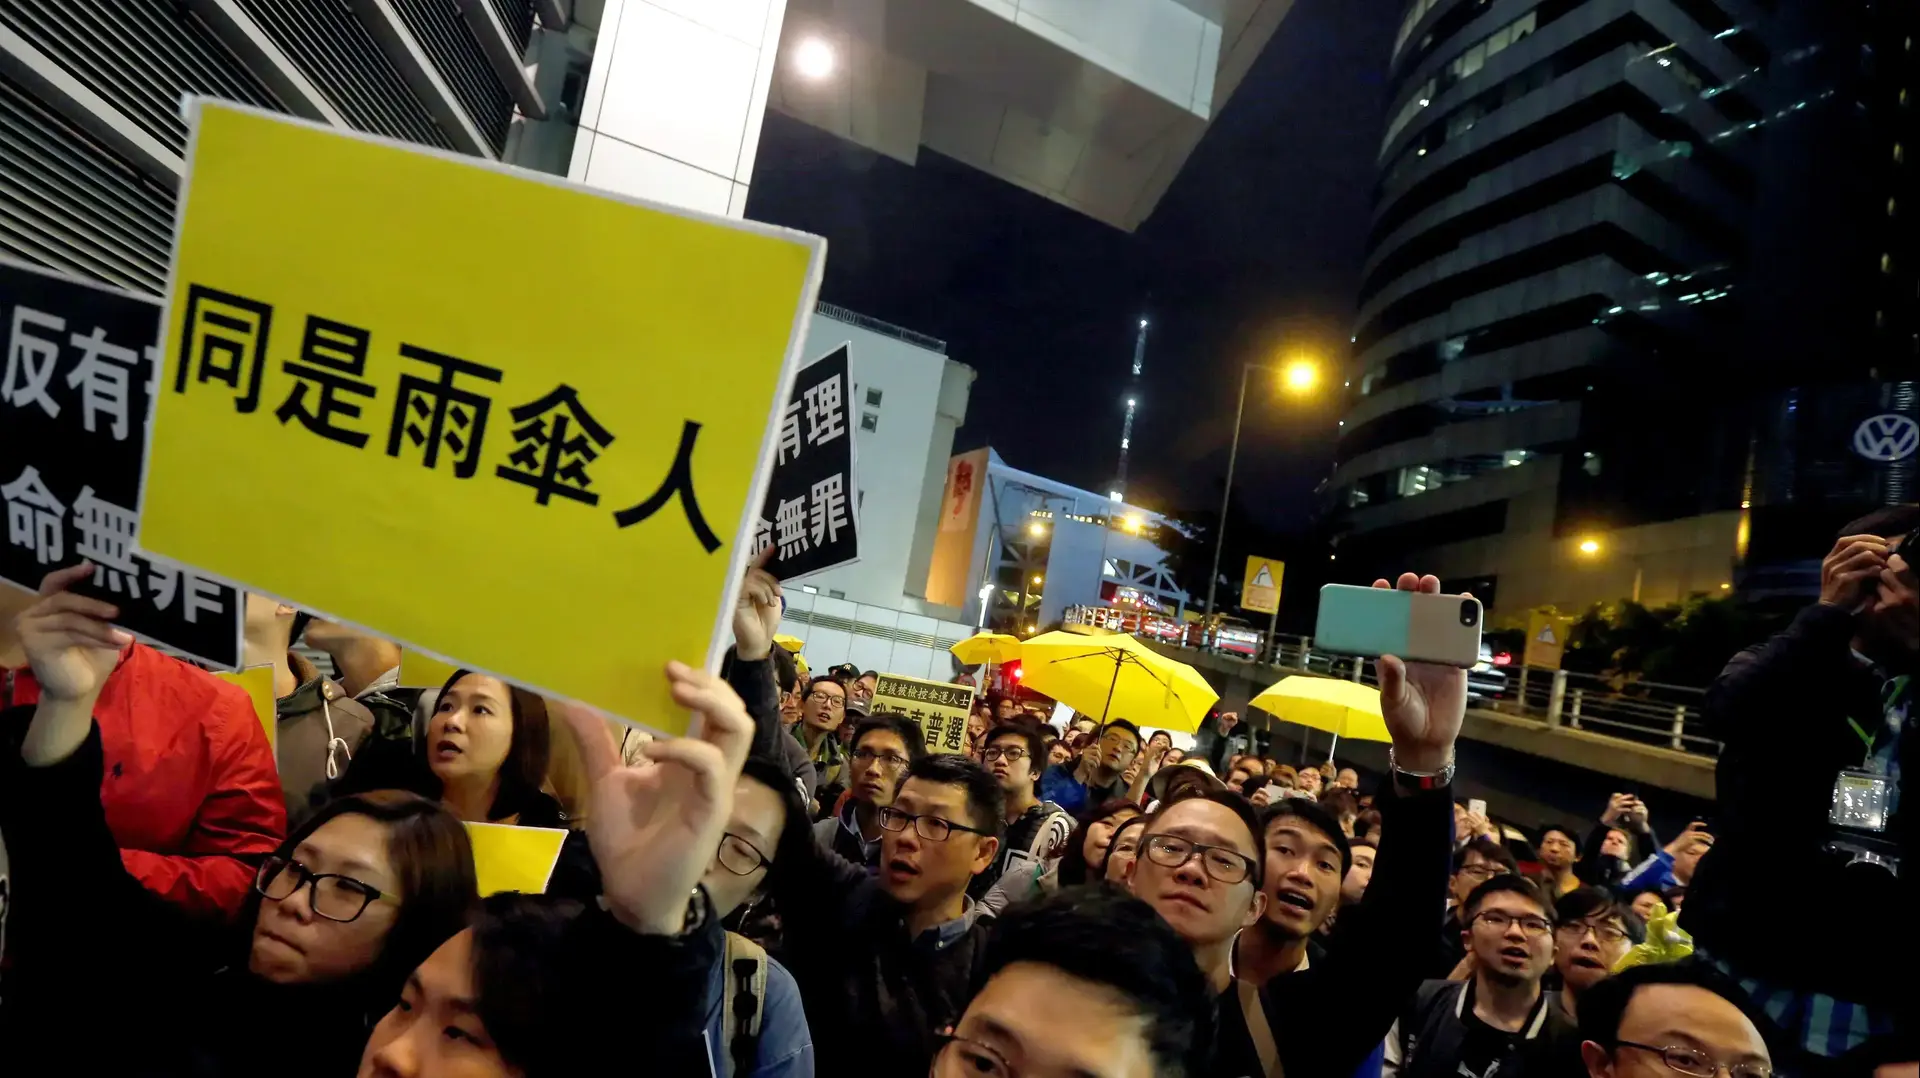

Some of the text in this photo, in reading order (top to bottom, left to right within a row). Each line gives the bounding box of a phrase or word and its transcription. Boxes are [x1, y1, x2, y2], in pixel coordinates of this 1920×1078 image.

[1, 304, 158, 441] 反有
[174, 283, 723, 555] 同是雨傘人
